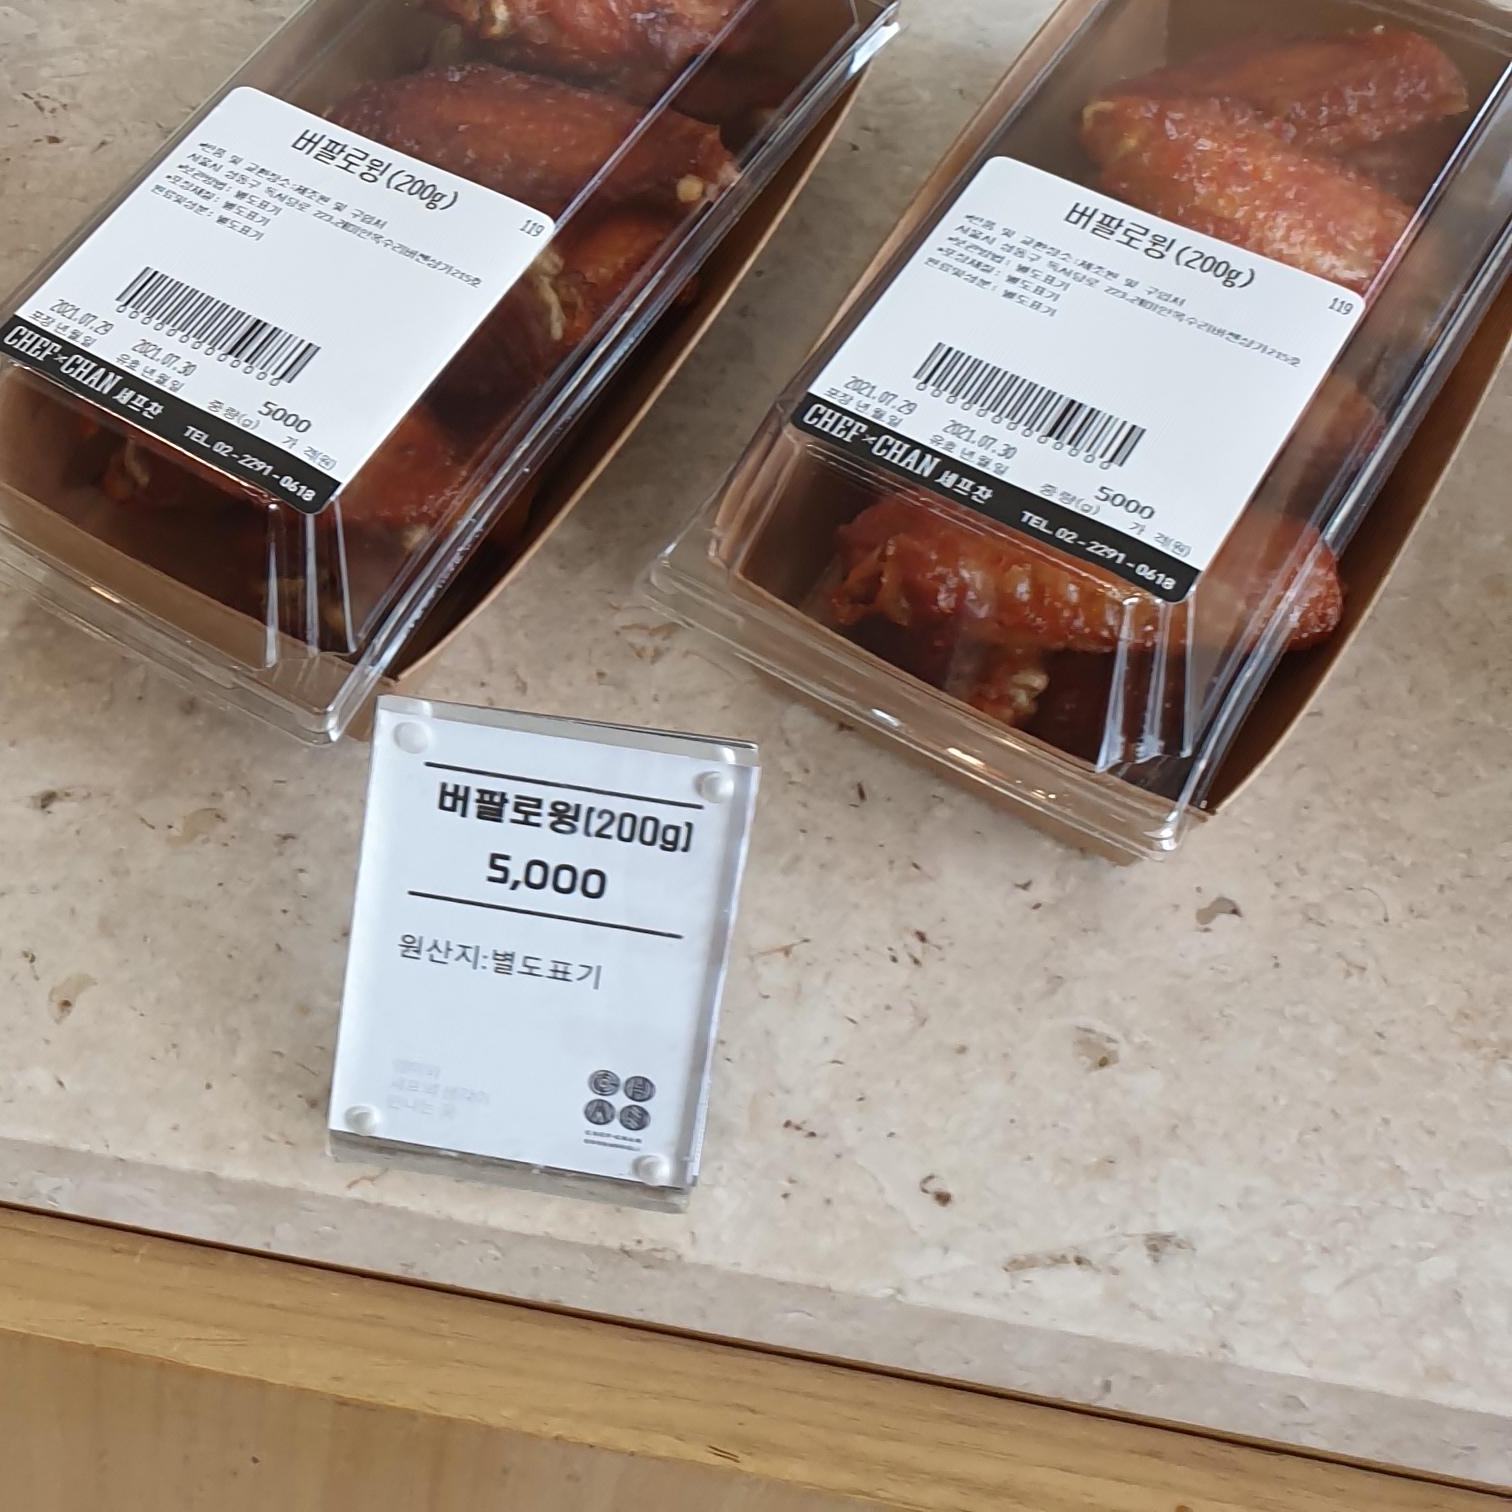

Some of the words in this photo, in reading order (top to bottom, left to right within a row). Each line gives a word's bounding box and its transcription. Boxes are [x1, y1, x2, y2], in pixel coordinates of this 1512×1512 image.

[290, 129, 458, 210] 버팔로윙(200g)
[519, 219, 545, 236] 119
[1063, 202, 1255, 288] 버팔로윙(200g)
[1328, 297, 1353, 315] 119
[49, 298, 114, 335] 2021.07.29
[131, 338, 197, 376] 2021.07.30
[257, 400, 311, 432] 5000
[843, 375, 917, 415] 2021.07.29
[941, 419, 1017, 459] 2021.07.30
[1094, 485, 1155, 519] 5000
[486, 852, 607, 900] 5,000
[398, 933, 602, 990] 원산지:별도표기
